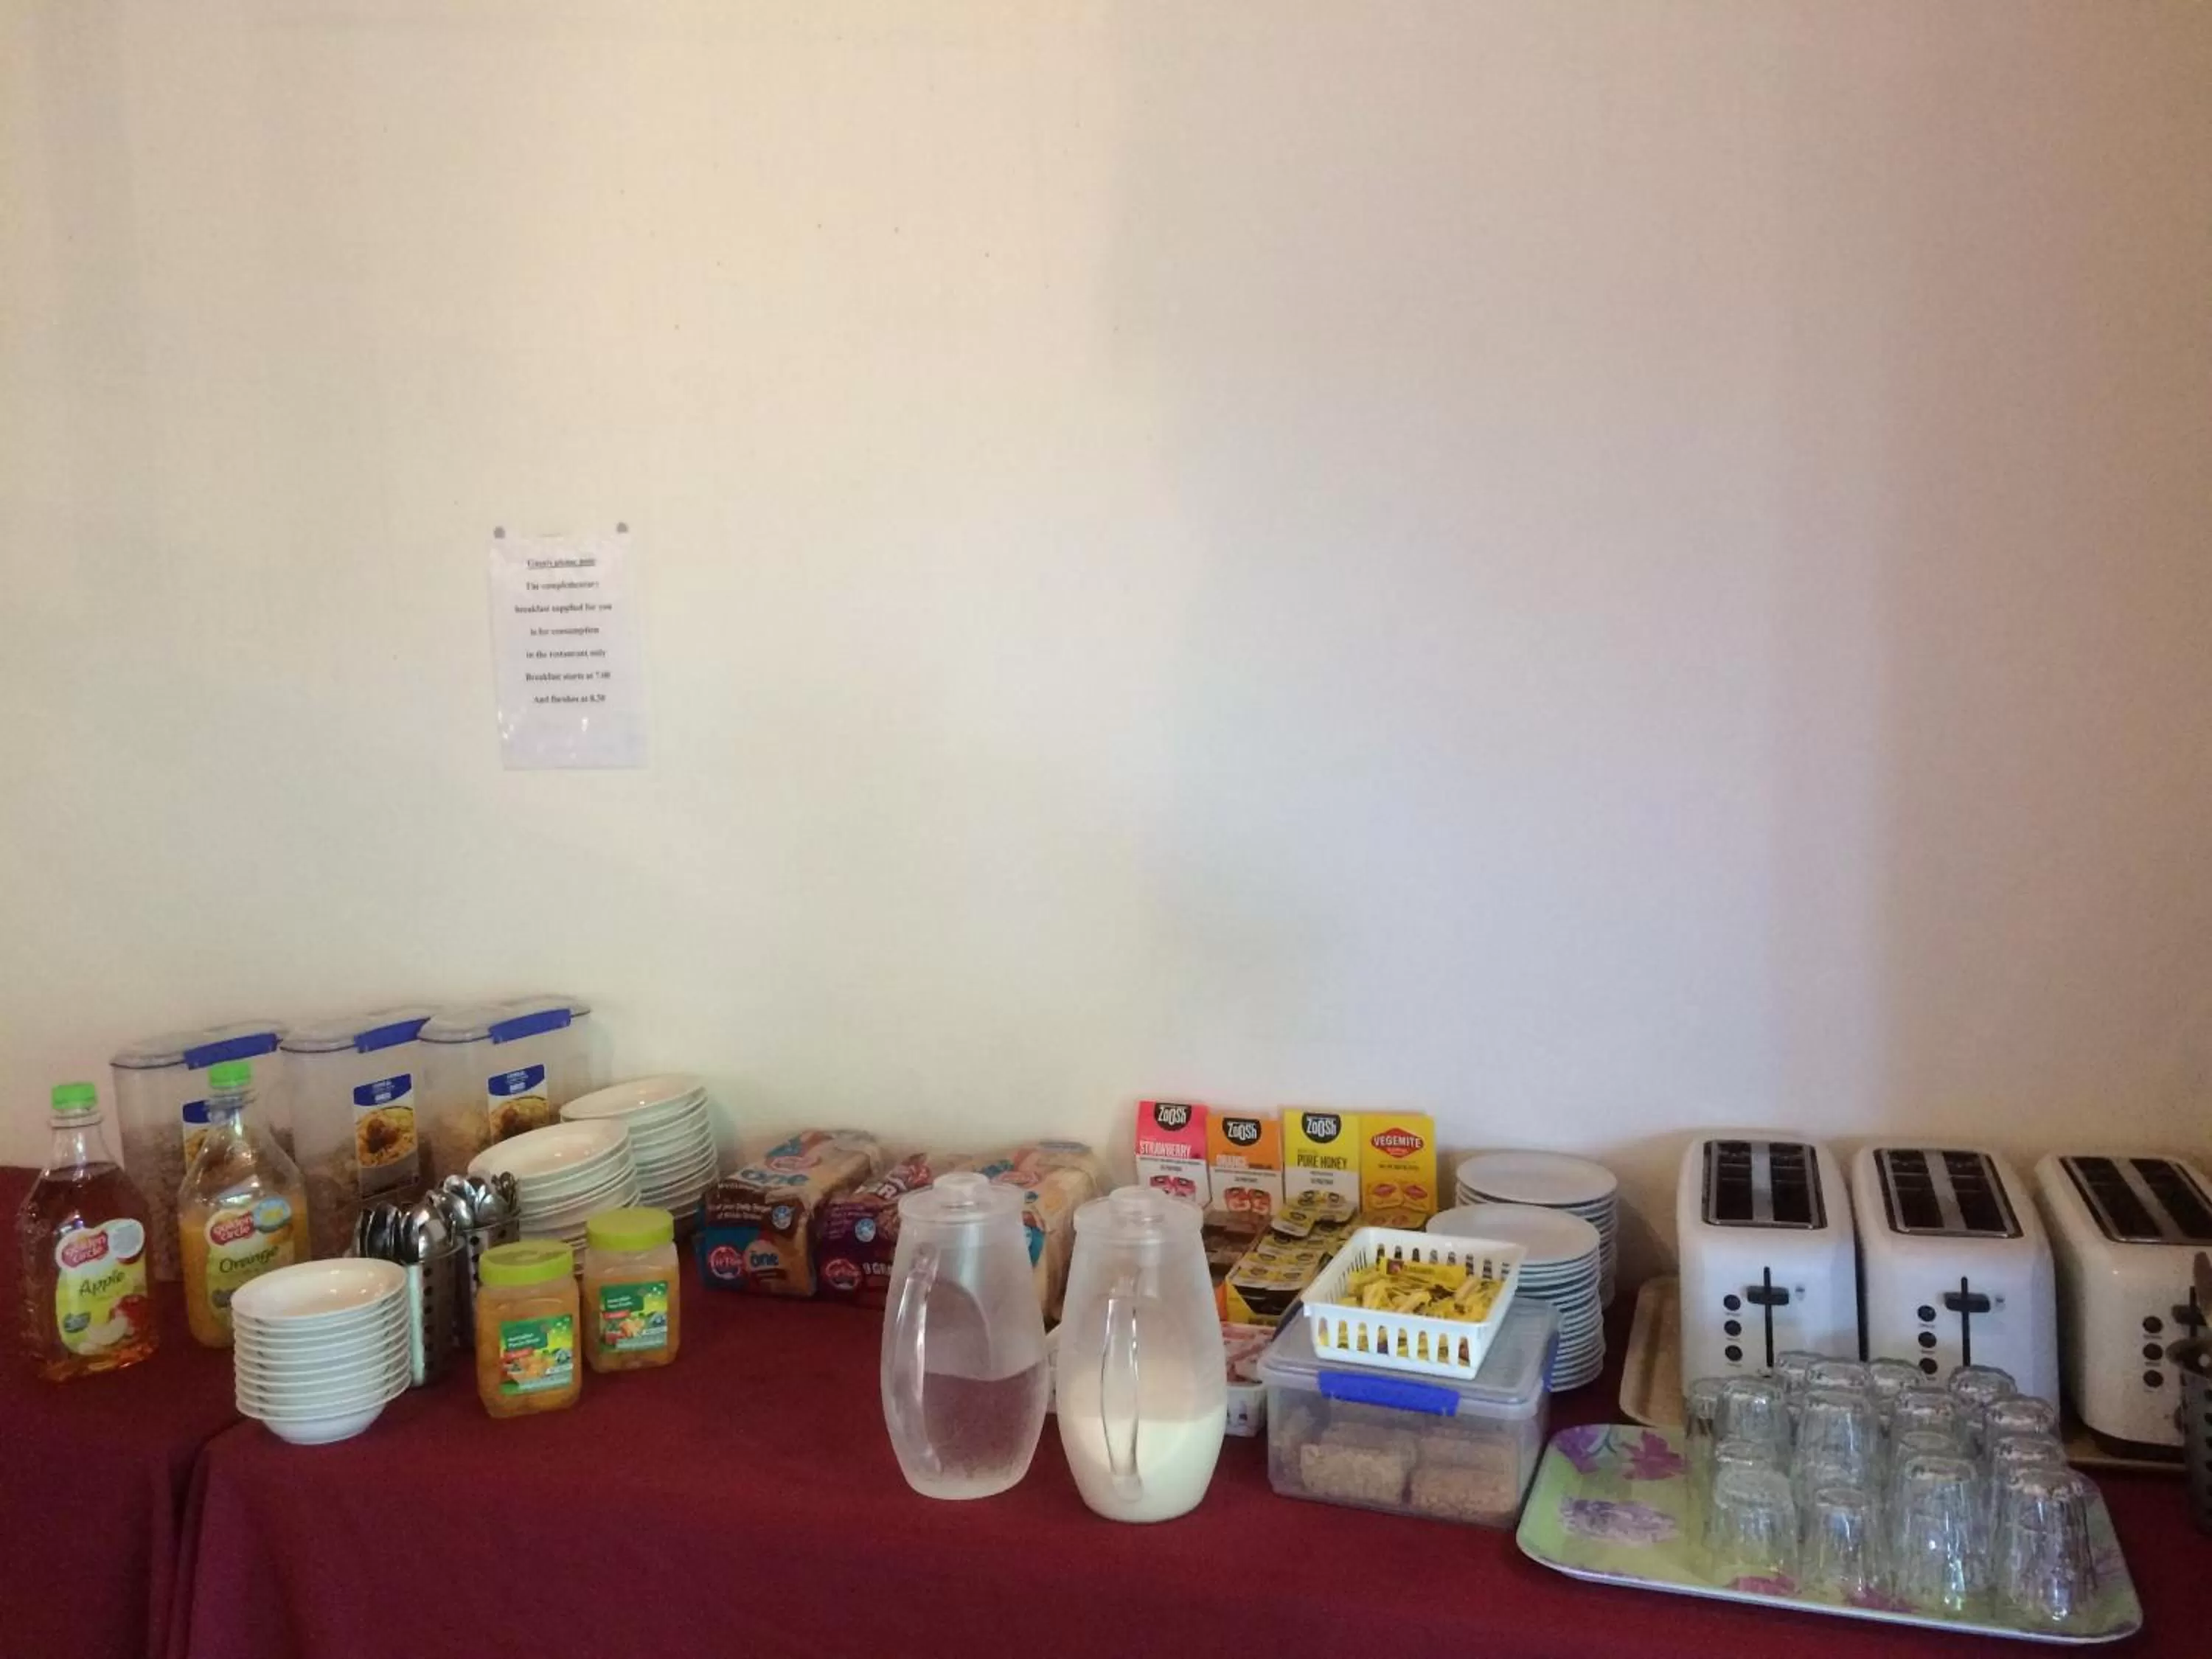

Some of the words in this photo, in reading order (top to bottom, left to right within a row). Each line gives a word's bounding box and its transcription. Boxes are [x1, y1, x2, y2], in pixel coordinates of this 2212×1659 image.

[514, 604, 550, 613] breakfast
[551, 603, 583, 613] supplied
[584, 603, 597, 611] for
[598, 603, 613, 613] you
[538, 627, 549, 636] for
[550, 626, 599, 636] consumption
[535, 650, 547, 658] the
[589, 649, 606, 658] only
[526, 672, 562, 681] Breakfast
[1374, 1135, 1421, 1148] VEGEMITE
[1139, 1140, 1192, 1159] STRAWBERRY
[1297, 1154, 1319, 1167] PURE
[1321, 1155, 1348, 1170] HONEY
[219, 1246, 279, 1273] Orange
[78, 1269, 125, 1297] Apple
